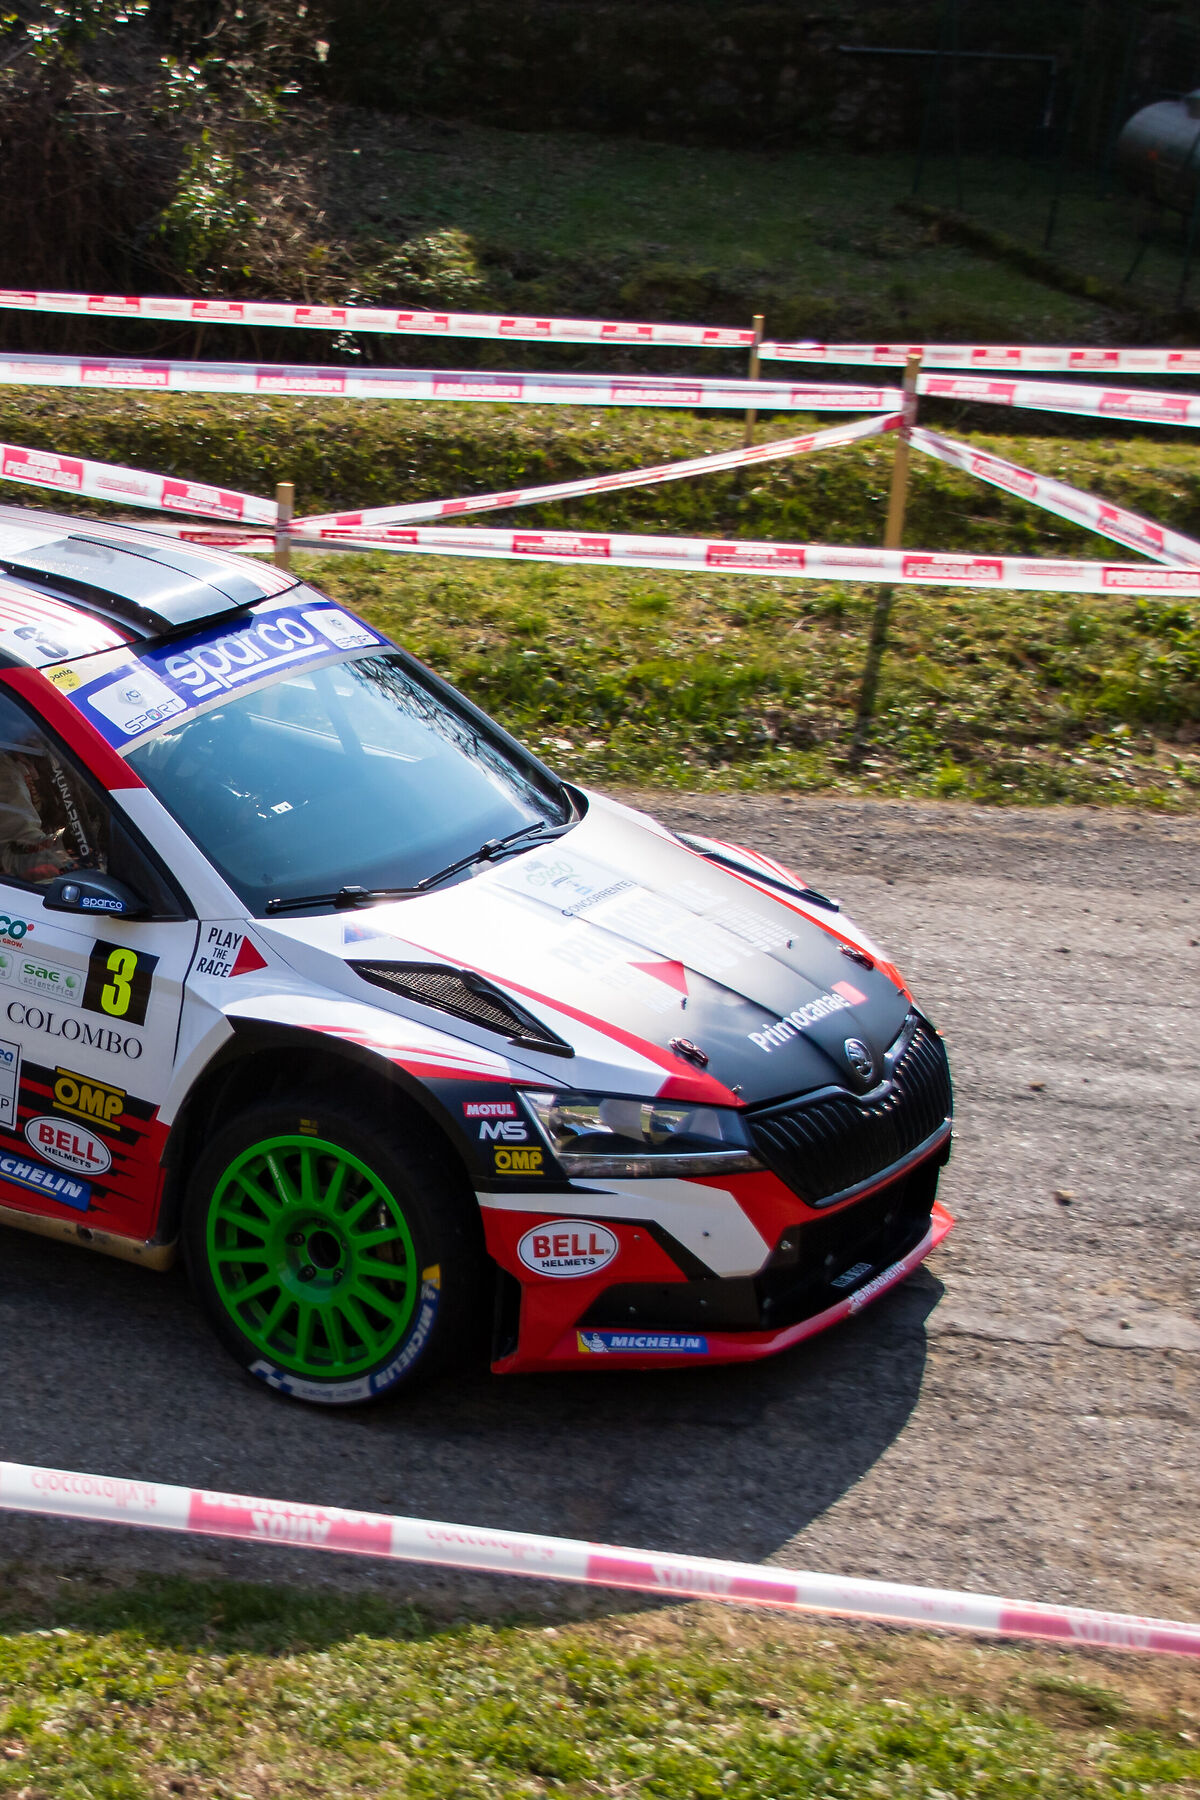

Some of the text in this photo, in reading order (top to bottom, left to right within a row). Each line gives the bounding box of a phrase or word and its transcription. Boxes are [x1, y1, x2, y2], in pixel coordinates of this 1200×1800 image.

[164, 617, 316, 690] sparco
[124, 698, 180, 733] SPORT
[81, 895, 124, 911] sparco
[2, 938, 24, 949] GROW.
[207, 927, 243, 950] PLAY
[212, 948, 229, 960] THE
[23, 964, 61, 983] sae
[196, 957, 232, 978] RACE
[23, 976, 74, 998] scientifica
[100, 948, 138, 1016] 3
[7, 1000, 143, 1060] COLOMBO
[53, 1077, 125, 1121] OMP
[466, 1103, 515, 1117] MOTUL
[479, 1120, 528, 1141] MS
[38, 1123, 100, 1164] BELL
[44, 1145, 92, 1169] HELMETS
[494, 1150, 543, 1171] OMP
[532, 1233, 604, 1258] BELL
[541, 1257, 597, 1269] HELMETS
[374, 1303, 434, 1389] MICHELIN
[611, 1335, 700, 1348] MICHELIN
